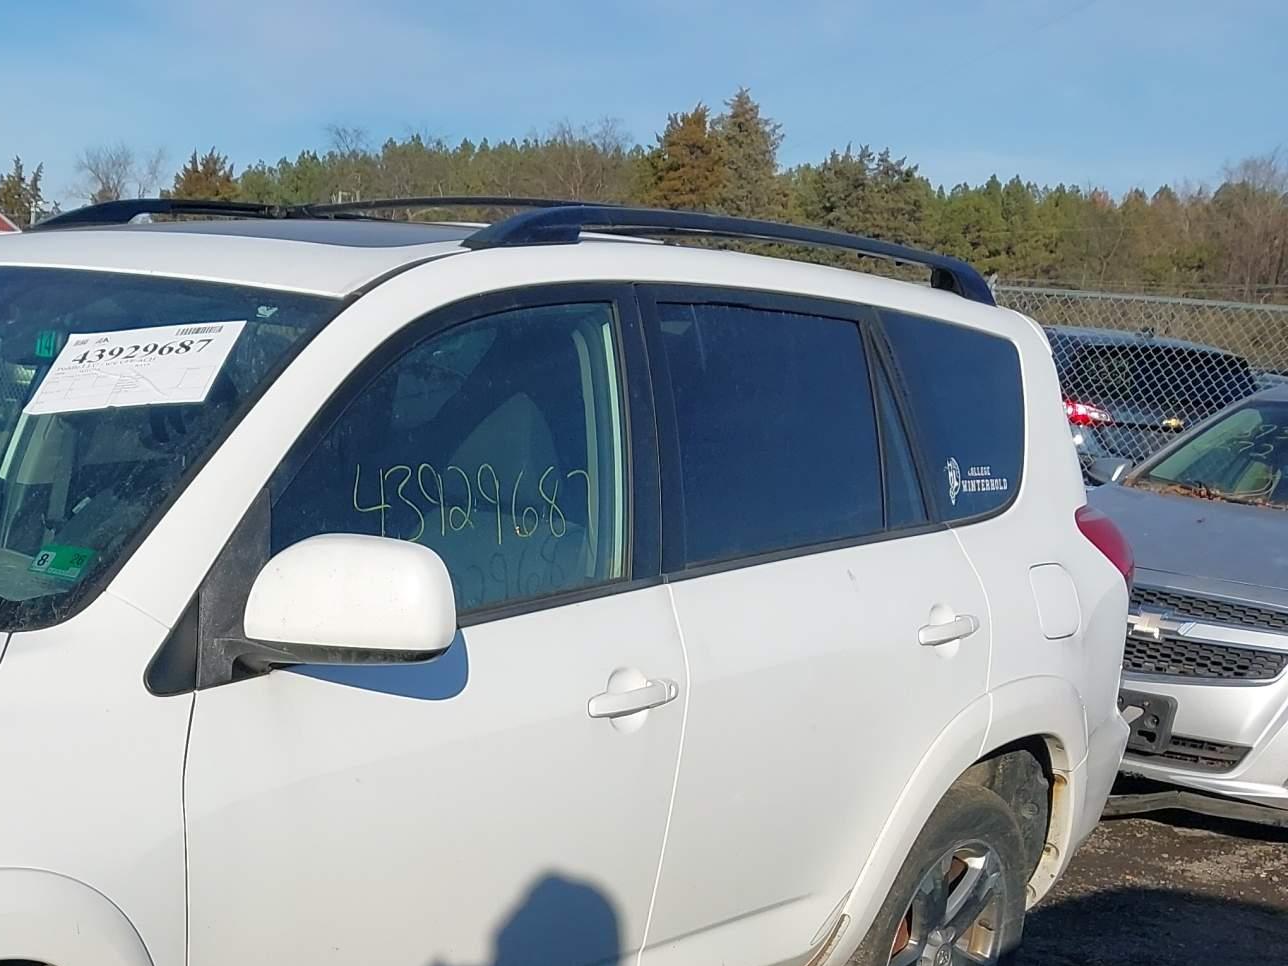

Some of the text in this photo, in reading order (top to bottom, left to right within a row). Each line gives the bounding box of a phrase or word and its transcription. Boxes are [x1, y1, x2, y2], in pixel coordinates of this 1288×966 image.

[72, 338, 215, 364] 43929687
[961, 478, 1008, 492] WINTERHOLD
[352, 462, 594, 550] 43929687
[37, 553, 50, 566] 8
